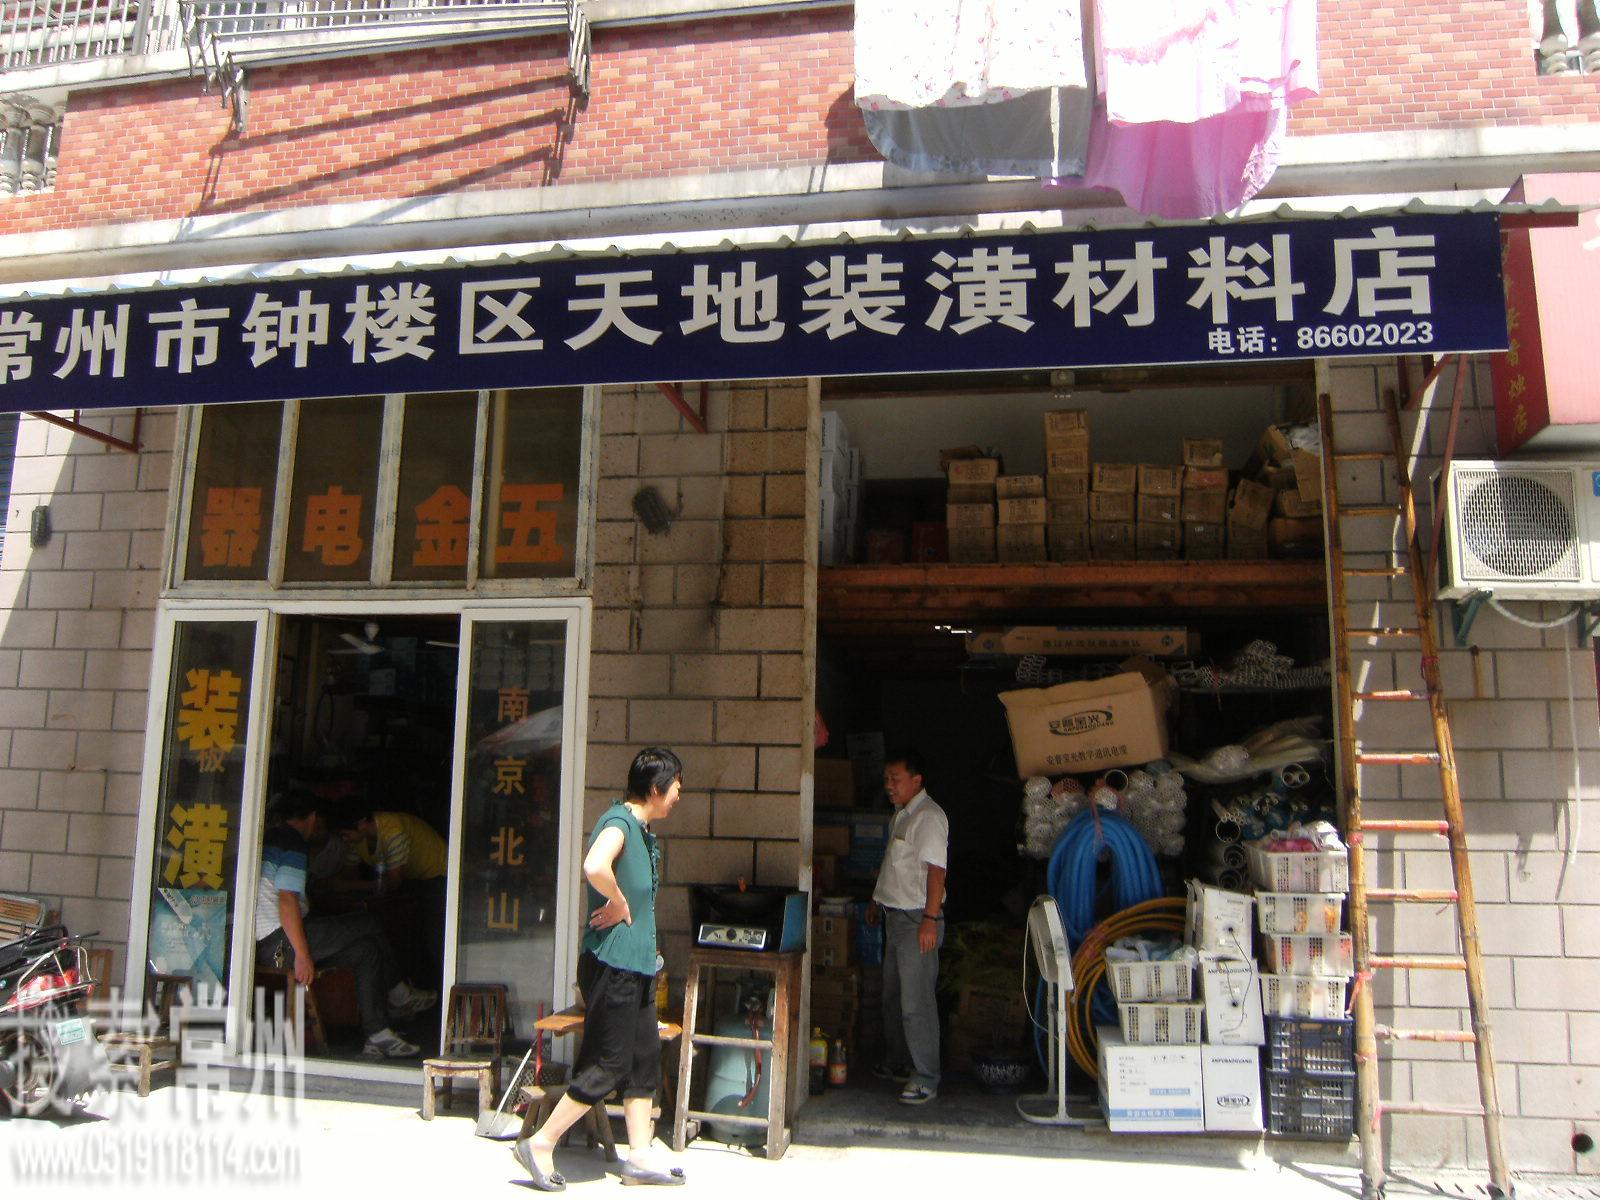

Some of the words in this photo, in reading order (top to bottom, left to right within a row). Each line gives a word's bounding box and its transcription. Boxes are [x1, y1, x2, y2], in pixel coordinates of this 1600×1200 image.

[1297, 322, 1435, 350] 86602023
[164, 667, 242, 890] 装潢
[487, 685, 530, 932] 南京北山
